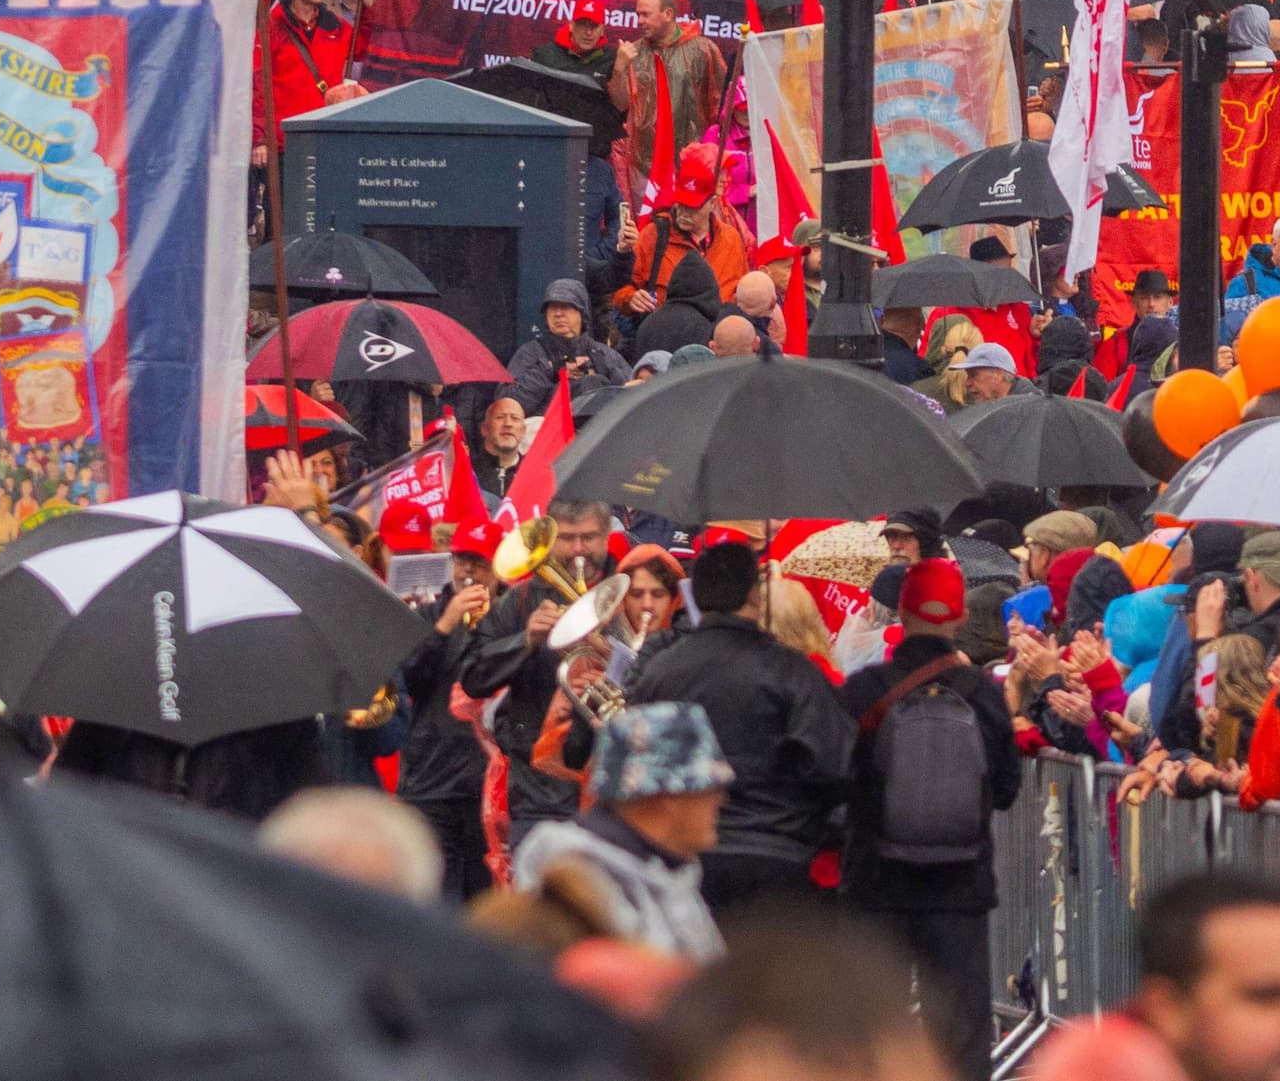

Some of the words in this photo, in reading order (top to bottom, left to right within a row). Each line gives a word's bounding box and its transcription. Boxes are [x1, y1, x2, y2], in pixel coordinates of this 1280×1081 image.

[358, 156, 389, 167] Castle
[391, 158, 398, 167] &
[401, 157, 447, 168] Cathedral
[358, 178, 391, 187] Market
[394, 178, 420, 188] Place
[988, 183, 1016, 195] unite
[358, 198, 410, 208] Millennium
[412, 199, 438, 208] Place
[306, 210, 316, 233] BR
[387, 483, 409, 498] FOR
[152, 590, 175, 638] Calvin
[155, 638, 177, 681] Klein
[158, 680, 182, 722] Golf
